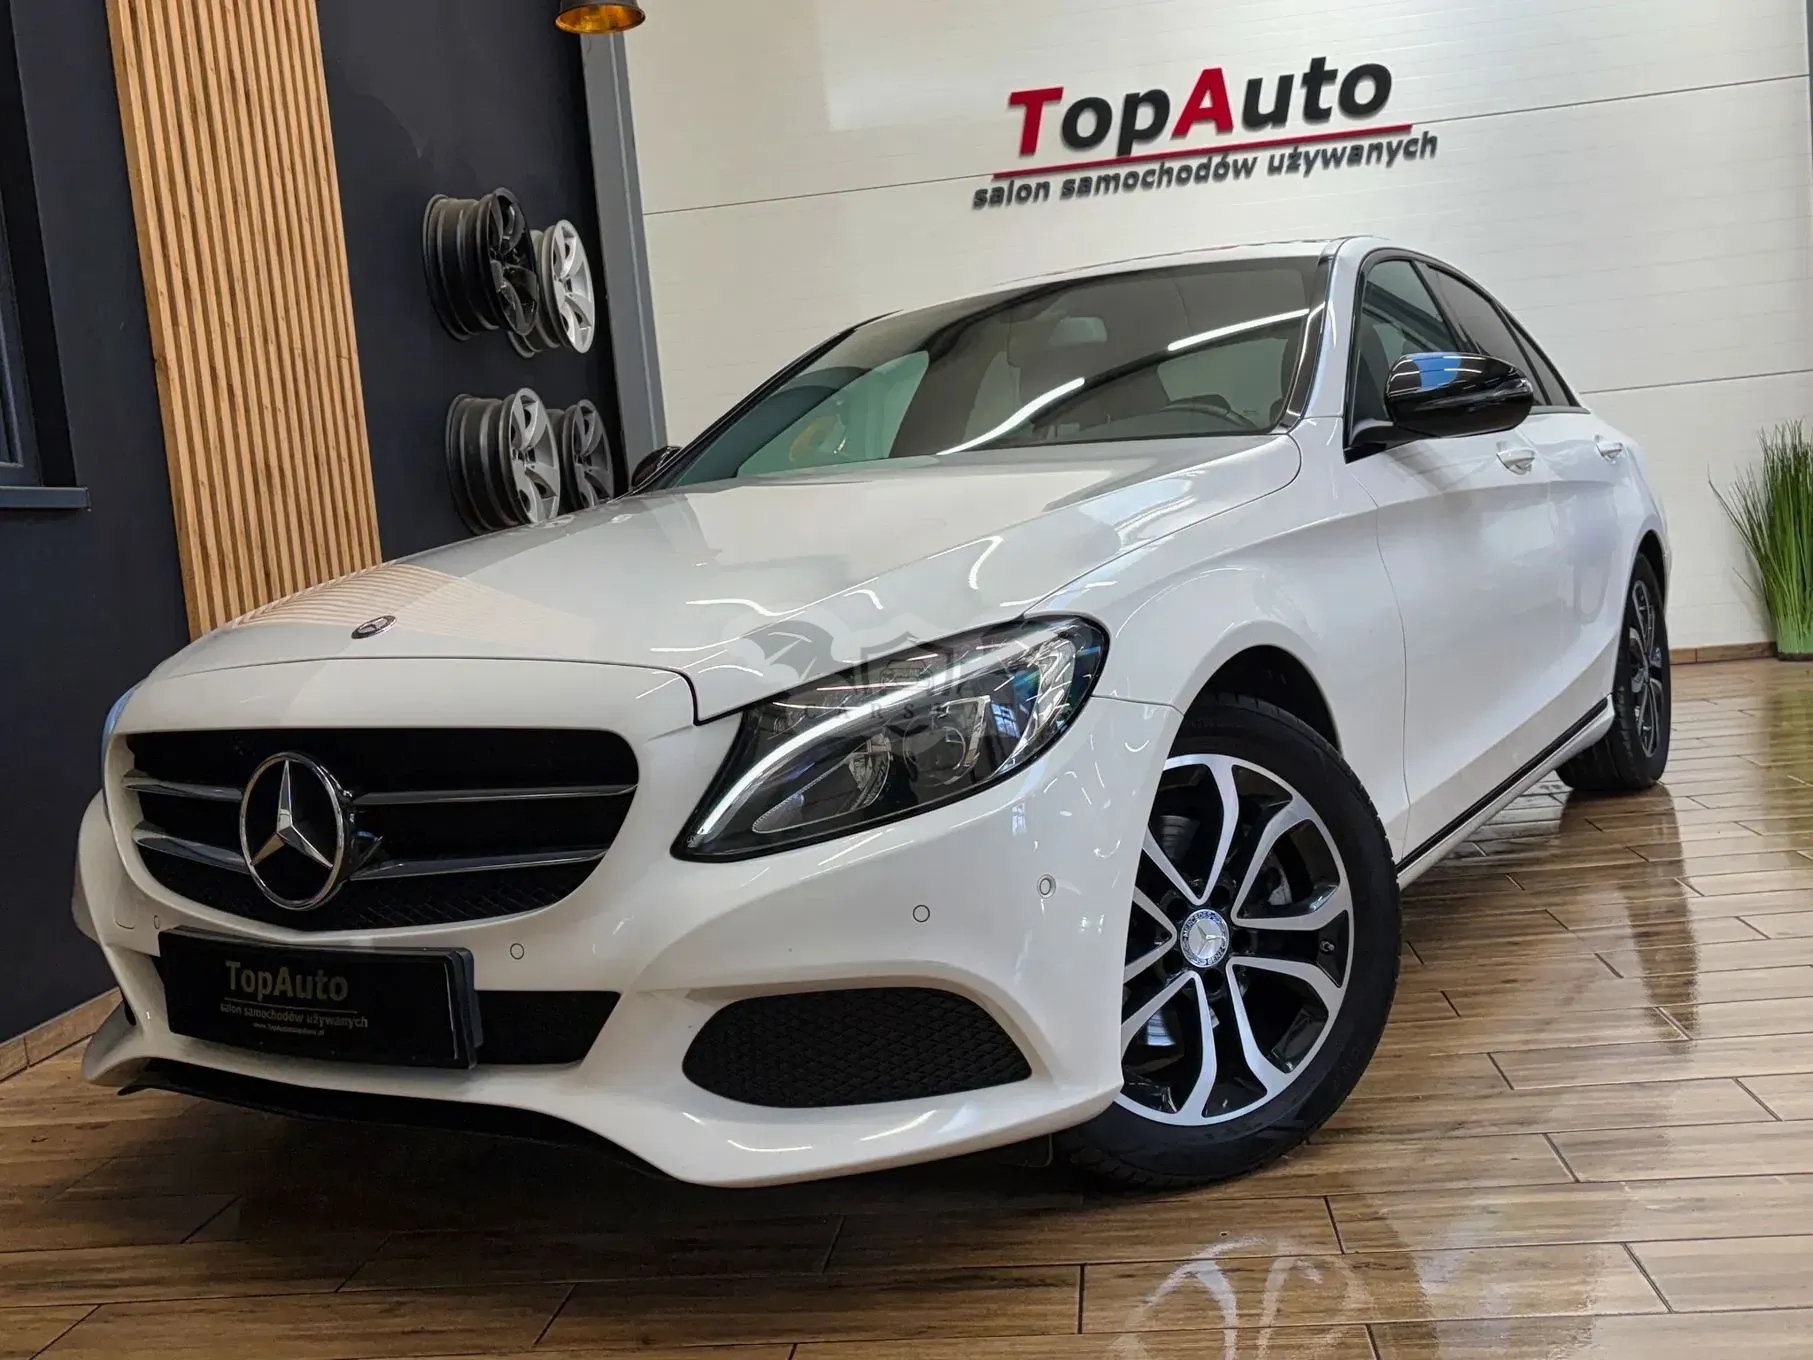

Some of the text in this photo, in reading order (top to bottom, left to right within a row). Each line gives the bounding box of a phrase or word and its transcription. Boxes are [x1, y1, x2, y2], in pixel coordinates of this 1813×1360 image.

[1008, 56, 1393, 158] TopAuto
[972, 130, 1438, 209] salon samochodów używanych
[220, 1003, 242, 1015] salon
[225, 959, 348, 1001] TopAuto
